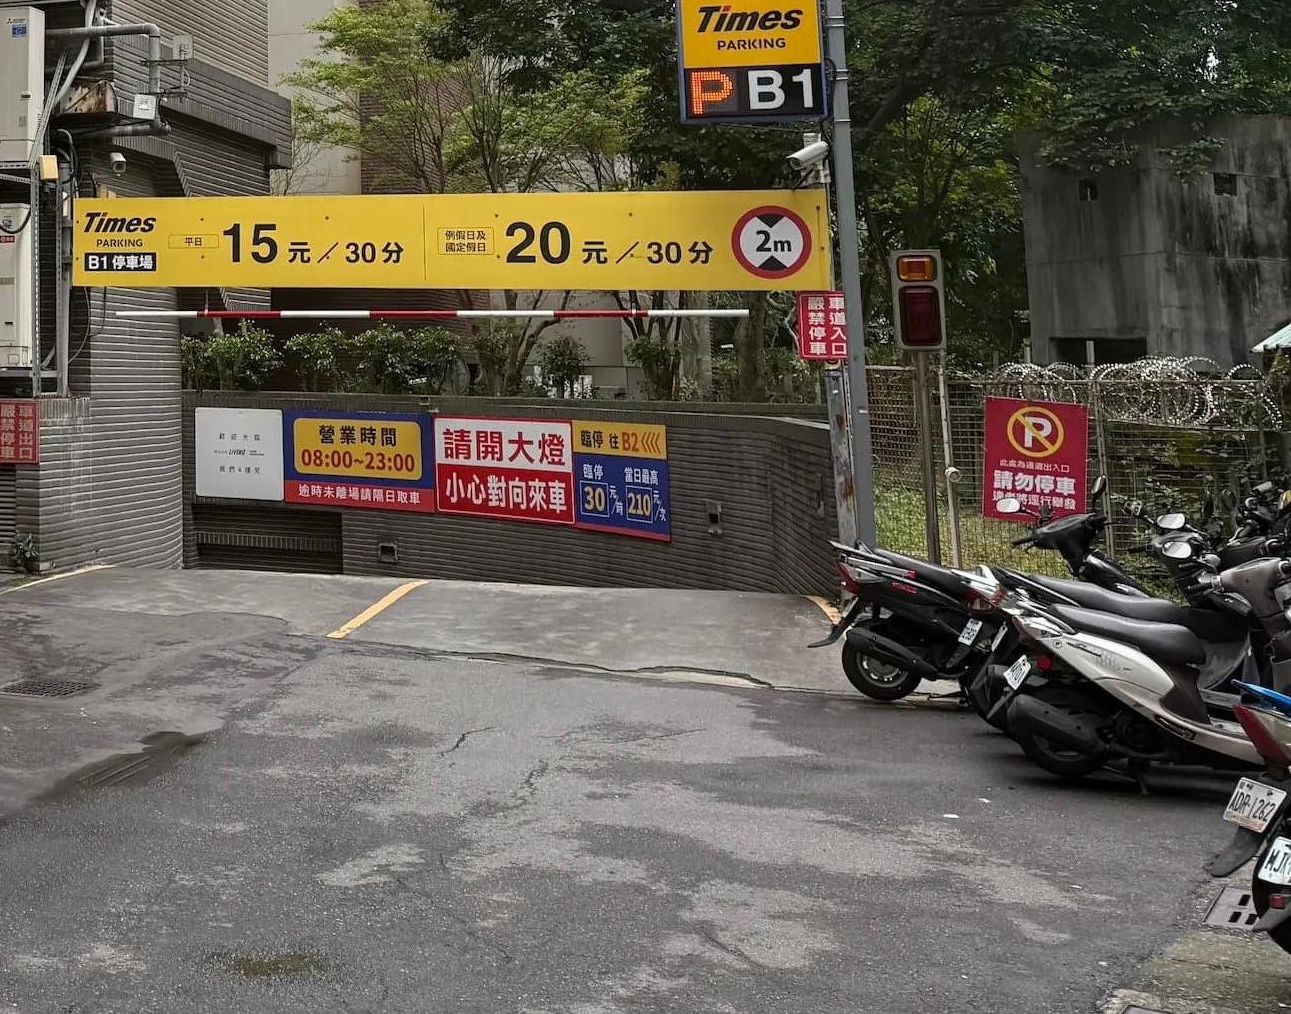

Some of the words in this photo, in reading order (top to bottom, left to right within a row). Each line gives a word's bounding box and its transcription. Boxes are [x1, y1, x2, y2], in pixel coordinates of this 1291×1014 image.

[697, 5, 803, 33] Times
[717, 37, 786, 51] PARKING
[692, 71, 733, 115] P
[747, 68, 814, 111] B1
[84, 212, 156, 233] Times
[445, 230, 486, 240] 例假日及
[96, 238, 143, 248] PARKING
[184, 236, 202, 247] 平日
[222, 223, 278, 263] 15
[445, 242, 486, 252] 國定假日
[505, 221, 571, 264] 20
[755, 229, 792, 253] 2m
[88, 255, 108, 270] B1
[112, 254, 154, 270] 停車場
[808, 297, 827, 355] 嚴禁停車
[829, 297, 846, 355] 車道入口
[0, 404, 15, 458] 嚴禁停車
[19, 405, 34, 459] 車道出口
[319, 425, 397, 447] 營業時間
[622, 432, 639, 452] B2
[443, 428, 566, 466] 請開大燈
[298, 483, 421, 505] 逾時未離場請隔日取車
[446, 472, 567, 514] 小心對向來車
[993, 469, 1076, 496] 請勿停車
[584, 486, 605, 511] 30
[628, 493, 651, 516] 210
